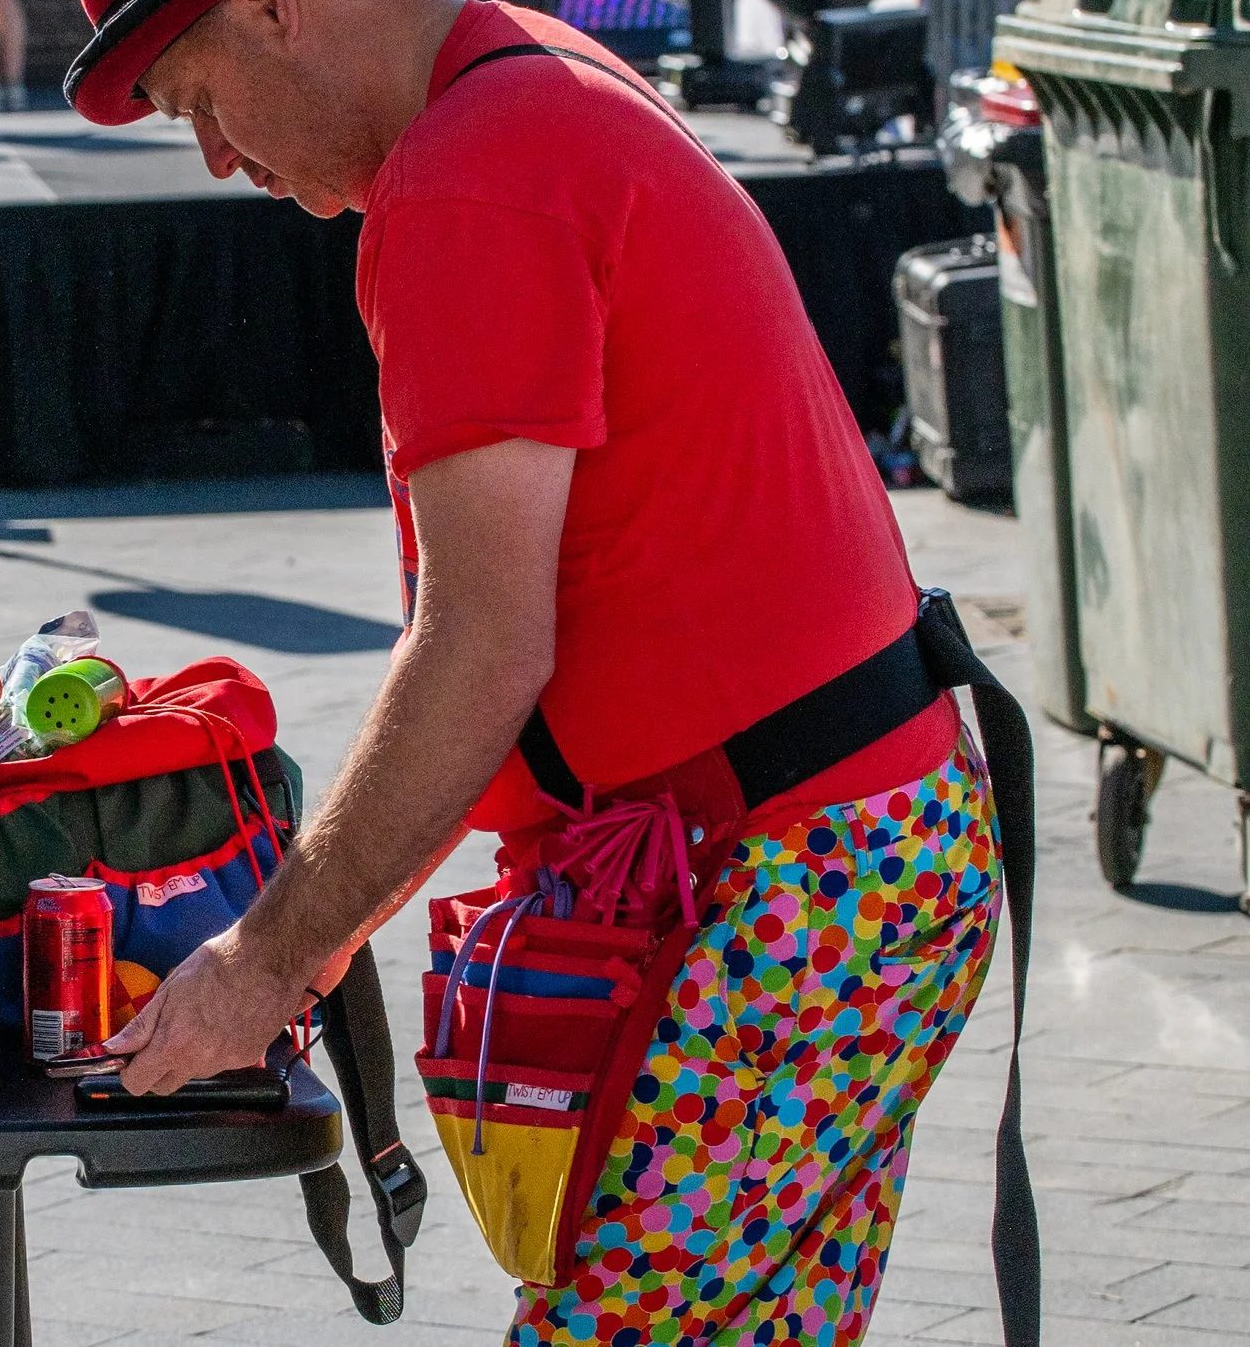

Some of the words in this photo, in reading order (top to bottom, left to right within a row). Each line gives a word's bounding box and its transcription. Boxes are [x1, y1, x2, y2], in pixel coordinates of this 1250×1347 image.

[138, 885, 166, 900] TWST
[167, 877, 186, 891] EM
[187, 875, 200, 887] UP
[508, 1083, 536, 1099] TWIST
[537, 1087, 554, 1102] EM
[557, 1089, 571, 1104] UP
